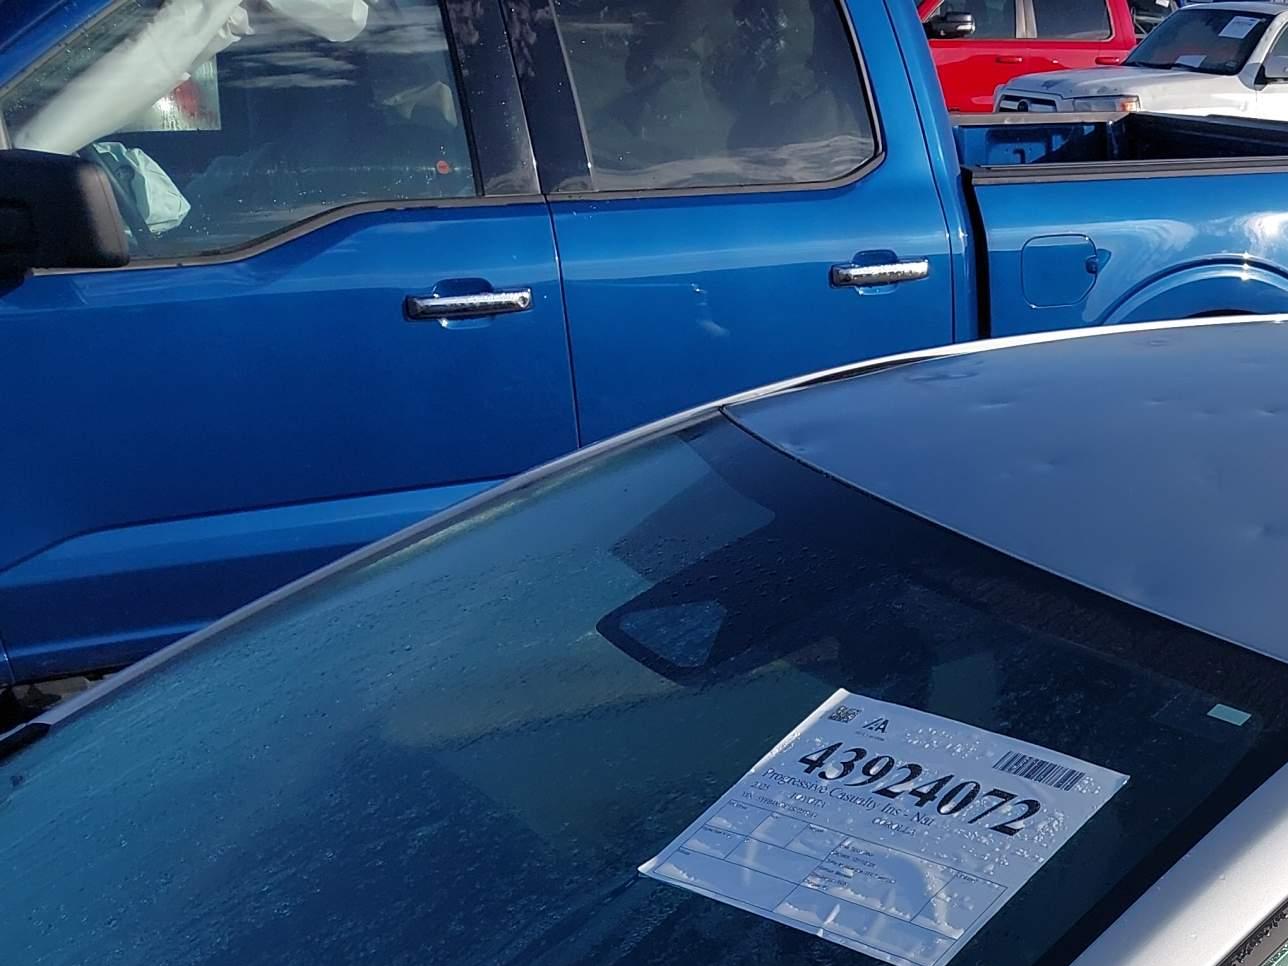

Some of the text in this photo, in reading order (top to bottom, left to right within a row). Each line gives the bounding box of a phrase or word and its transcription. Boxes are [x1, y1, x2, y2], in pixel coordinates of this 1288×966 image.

[761, 767, 829, 795] Progressive
[829, 786, 881, 811] Casualty
[882, 800, 900, 817] Ins
[797, 742, 1042, 836] 43924072
